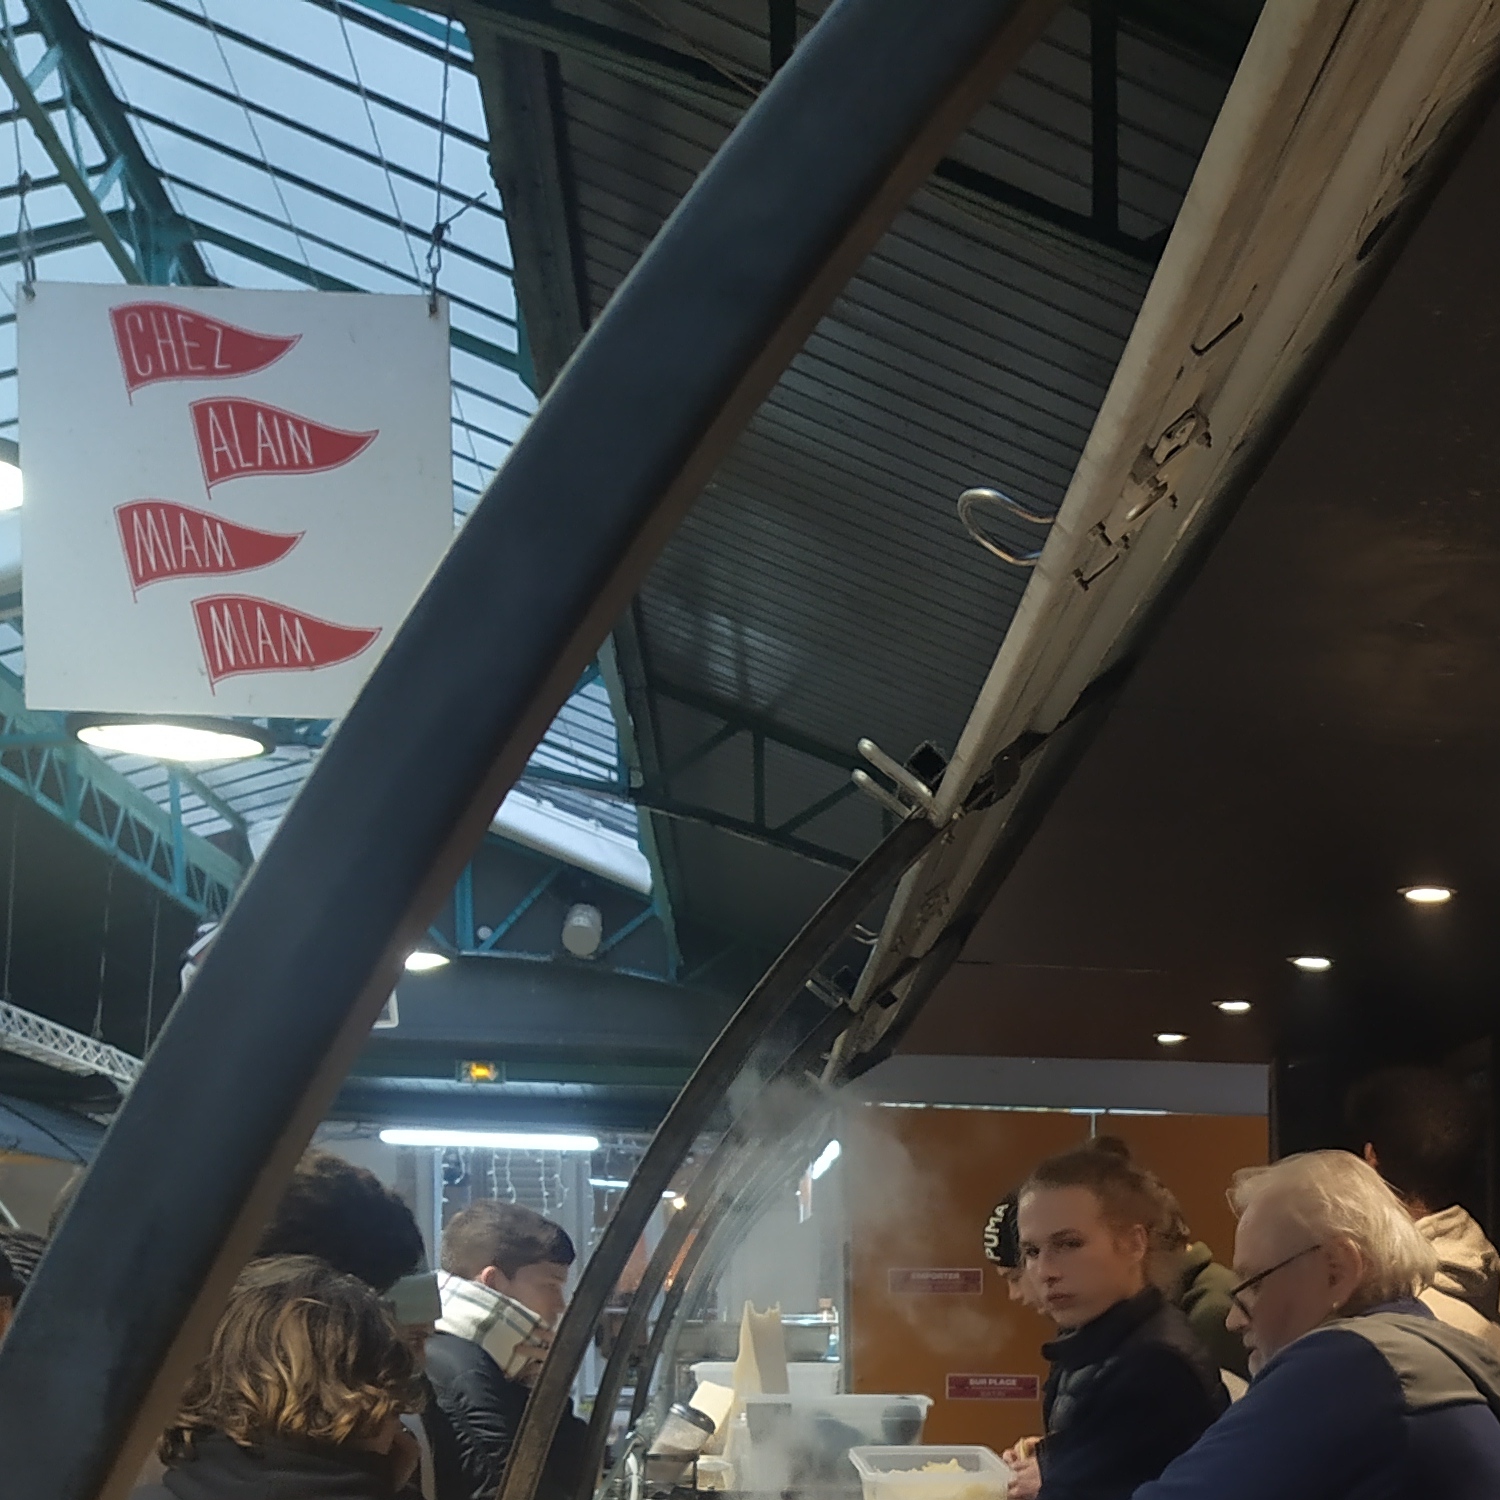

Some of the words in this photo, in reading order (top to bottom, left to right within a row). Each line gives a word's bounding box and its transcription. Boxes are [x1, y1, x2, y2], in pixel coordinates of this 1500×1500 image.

[124, 310, 232, 378] CHEZ
[206, 405, 314, 473] ALAIN
[131, 507, 237, 578] MIAM
[208, 602, 316, 673] MIAM
[984, 1203, 1009, 1261] PUMA
